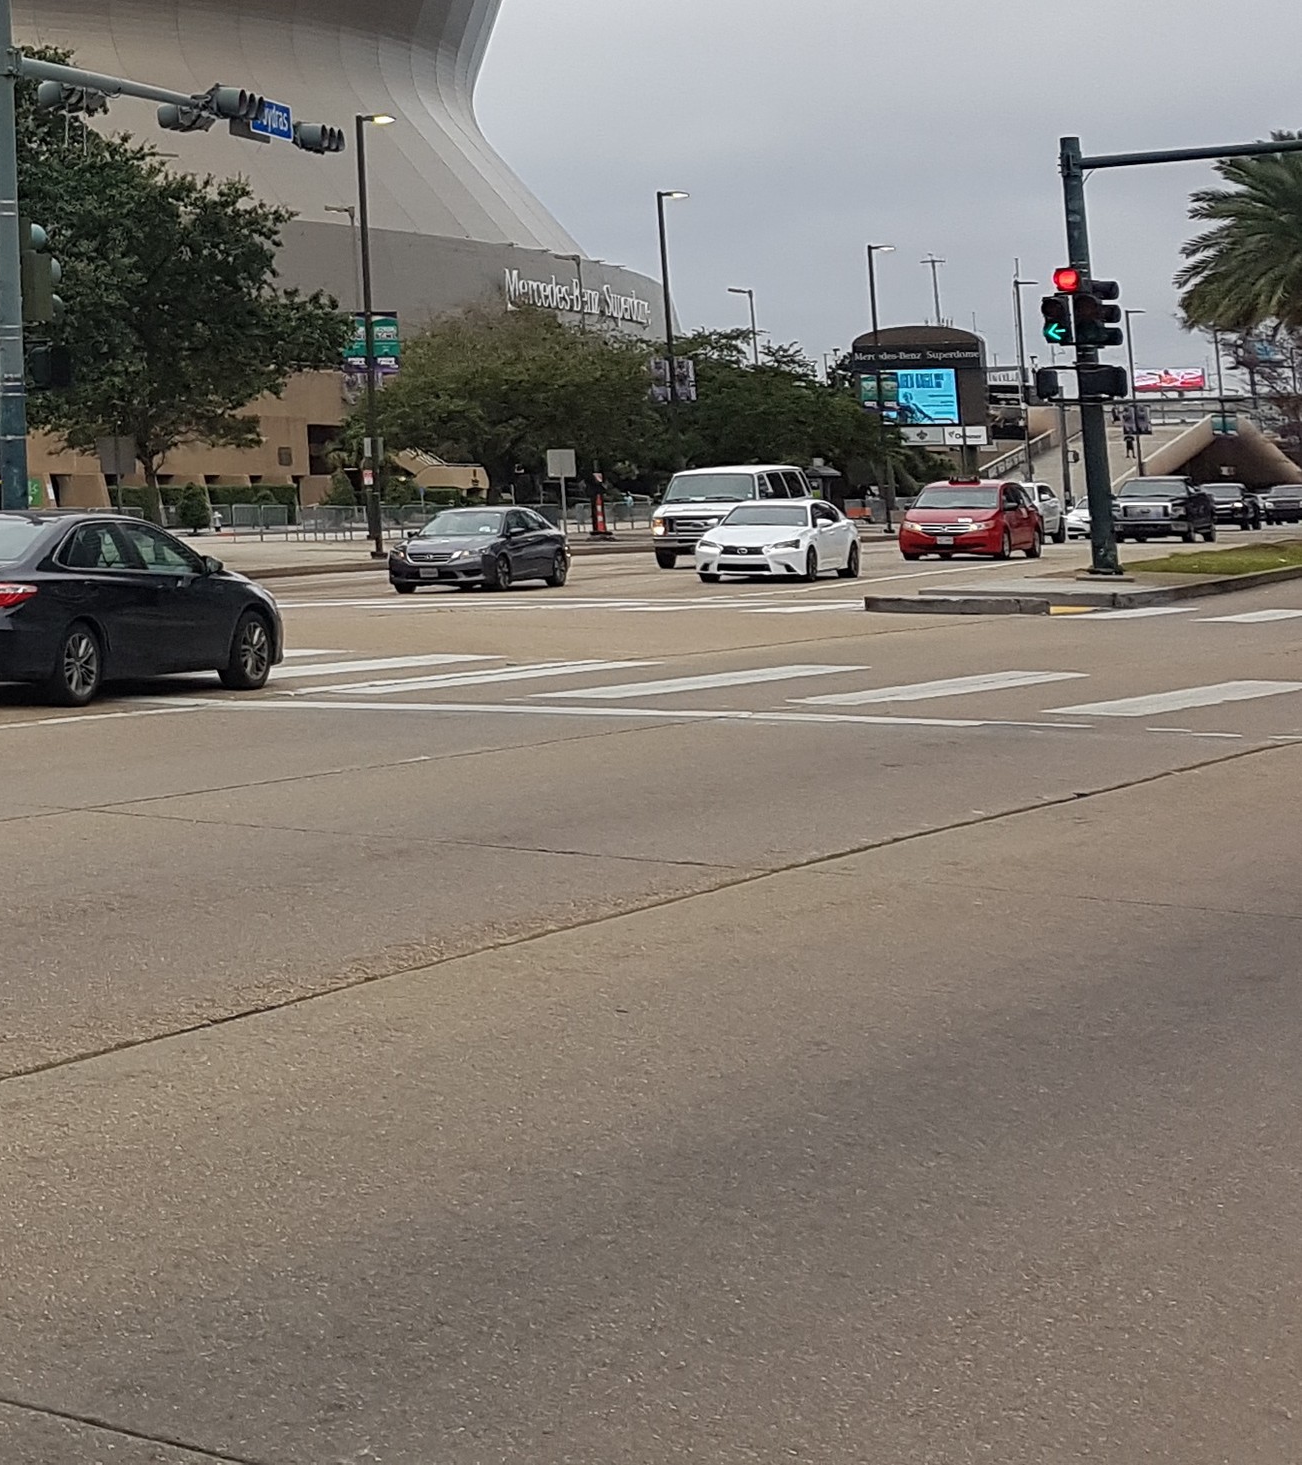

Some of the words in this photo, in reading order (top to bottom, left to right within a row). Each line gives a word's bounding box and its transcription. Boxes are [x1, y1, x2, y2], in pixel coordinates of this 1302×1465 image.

[262, 105, 289, 132] ydras
[854, 351, 922, 361] Meredes-Benz
[925, 350, 979, 361] Superdome
